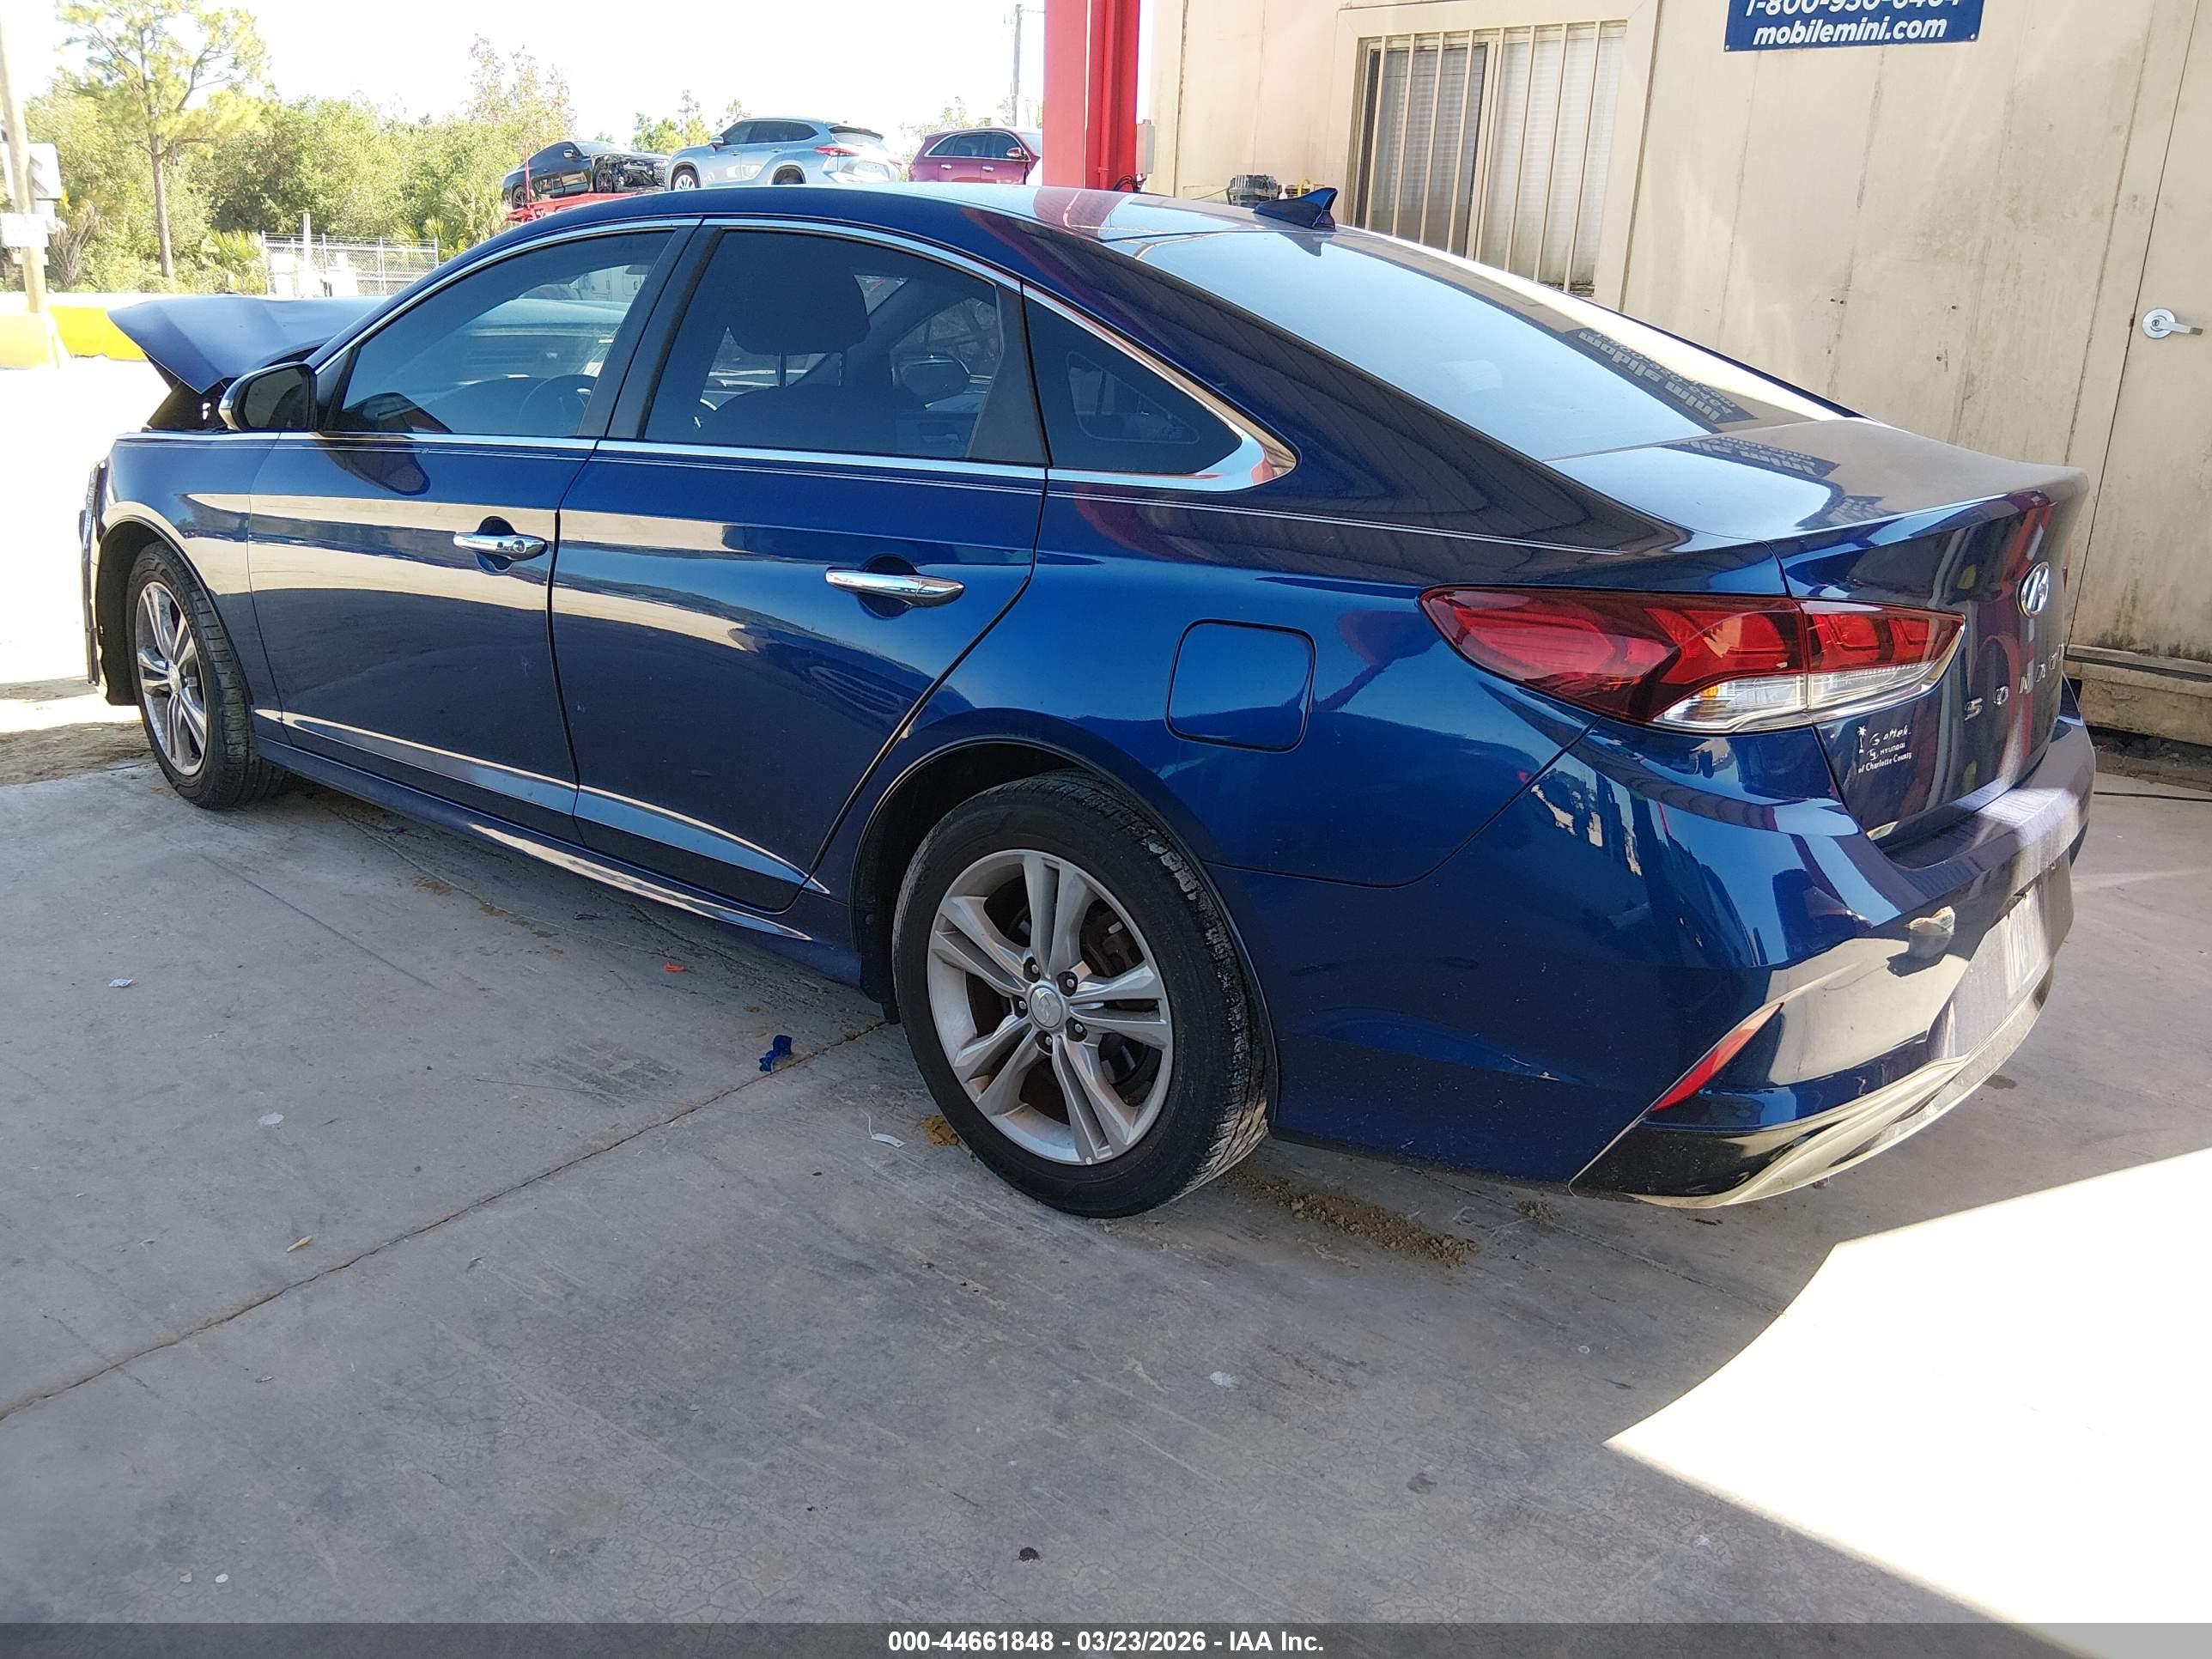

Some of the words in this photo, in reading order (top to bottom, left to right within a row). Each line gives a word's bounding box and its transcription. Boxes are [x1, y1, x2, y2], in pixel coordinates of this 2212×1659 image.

[1746, 0, 1960, 16] 1-800-9
[1753, 16, 1948, 46] mobilemini.com
[1880, 742, 1905, 756] HYUNDAI
[1858, 764, 1864, 774] of
[1865, 757, 1893, 772] Charlotte
[1893, 751, 1912, 763] County
